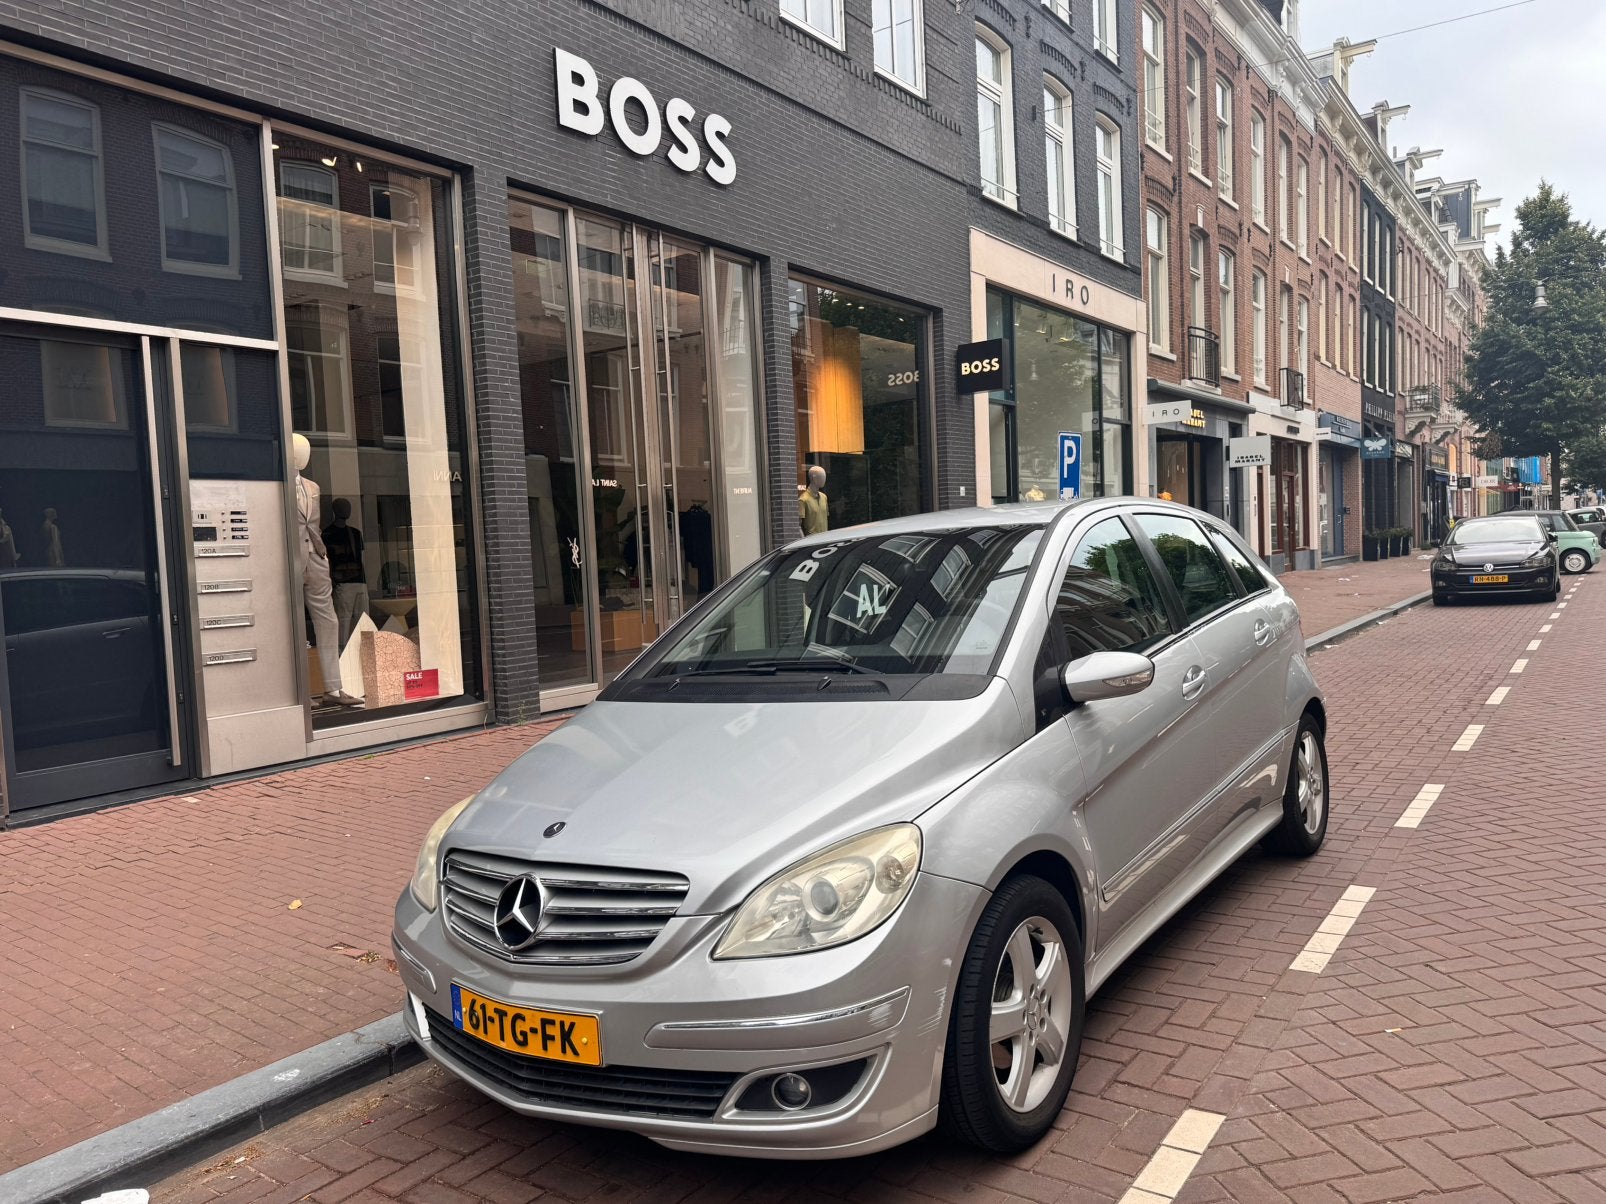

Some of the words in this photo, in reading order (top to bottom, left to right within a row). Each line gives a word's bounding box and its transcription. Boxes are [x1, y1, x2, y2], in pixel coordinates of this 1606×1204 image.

[555, 47, 737, 185] BOSS
[1052, 273, 1090, 306] IRO
[961, 357, 1000, 376] BOSS
[1152, 408, 1180, 418] IRO
[1063, 439, 1077, 479] P
[405, 671, 423, 681] SALE
[468, 998, 580, 1056] 61-TG-FK
